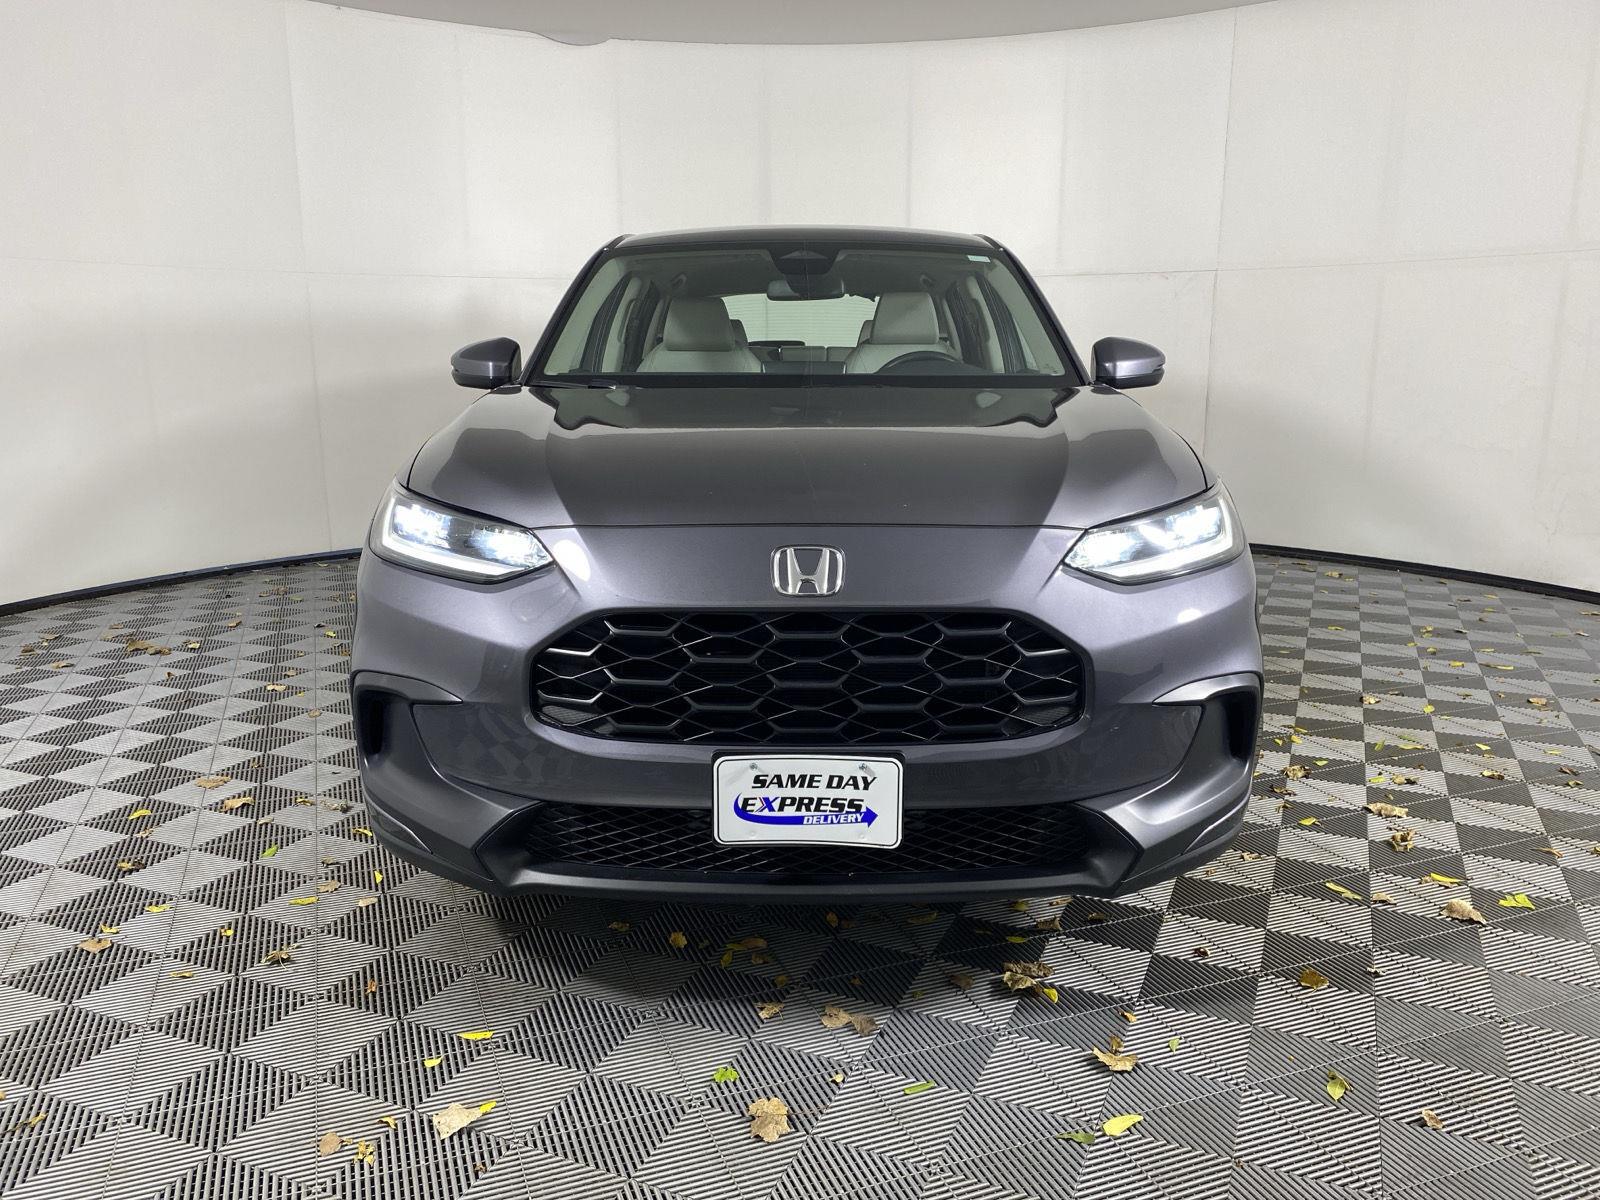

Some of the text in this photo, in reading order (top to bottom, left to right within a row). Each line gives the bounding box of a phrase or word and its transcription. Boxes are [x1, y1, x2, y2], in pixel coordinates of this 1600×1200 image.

[752, 774, 877, 791] SAME DAY
[741, 796, 864, 813] EXPRESS
[803, 813, 864, 825] DELIVERY
